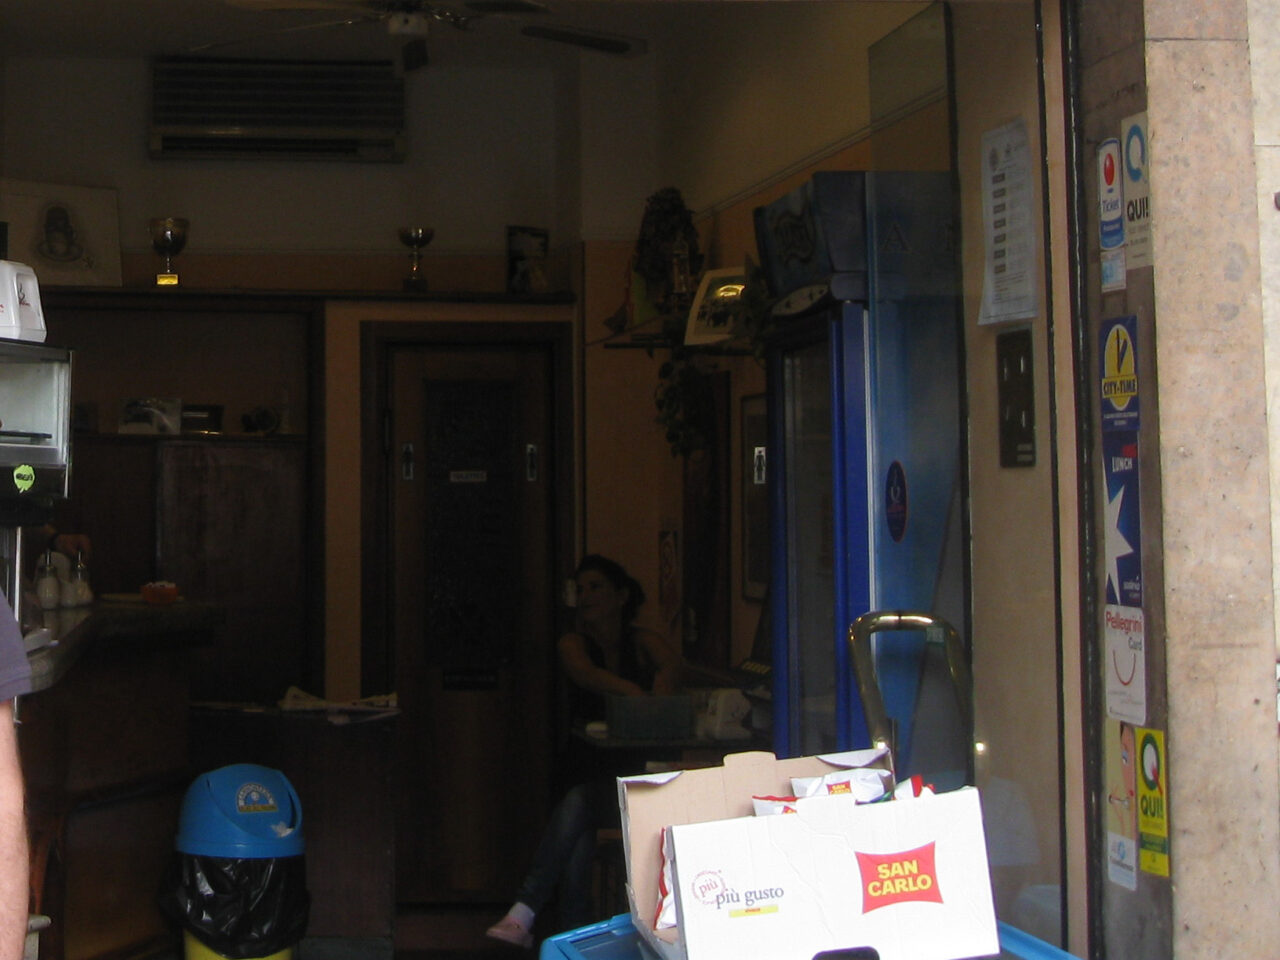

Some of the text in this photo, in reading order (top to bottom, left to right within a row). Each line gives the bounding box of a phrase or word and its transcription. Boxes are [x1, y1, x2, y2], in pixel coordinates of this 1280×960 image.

[1127, 196, 1149, 222] QUI!
[1111, 456, 1133, 473] LUNCH
[1105, 610, 1143, 635] Pellegrini
[876, 859, 919, 880] SAN
[698, 878, 719, 898] più
[867, 874, 933, 897] CARLO
[715, 886, 785, 909] più gusto
